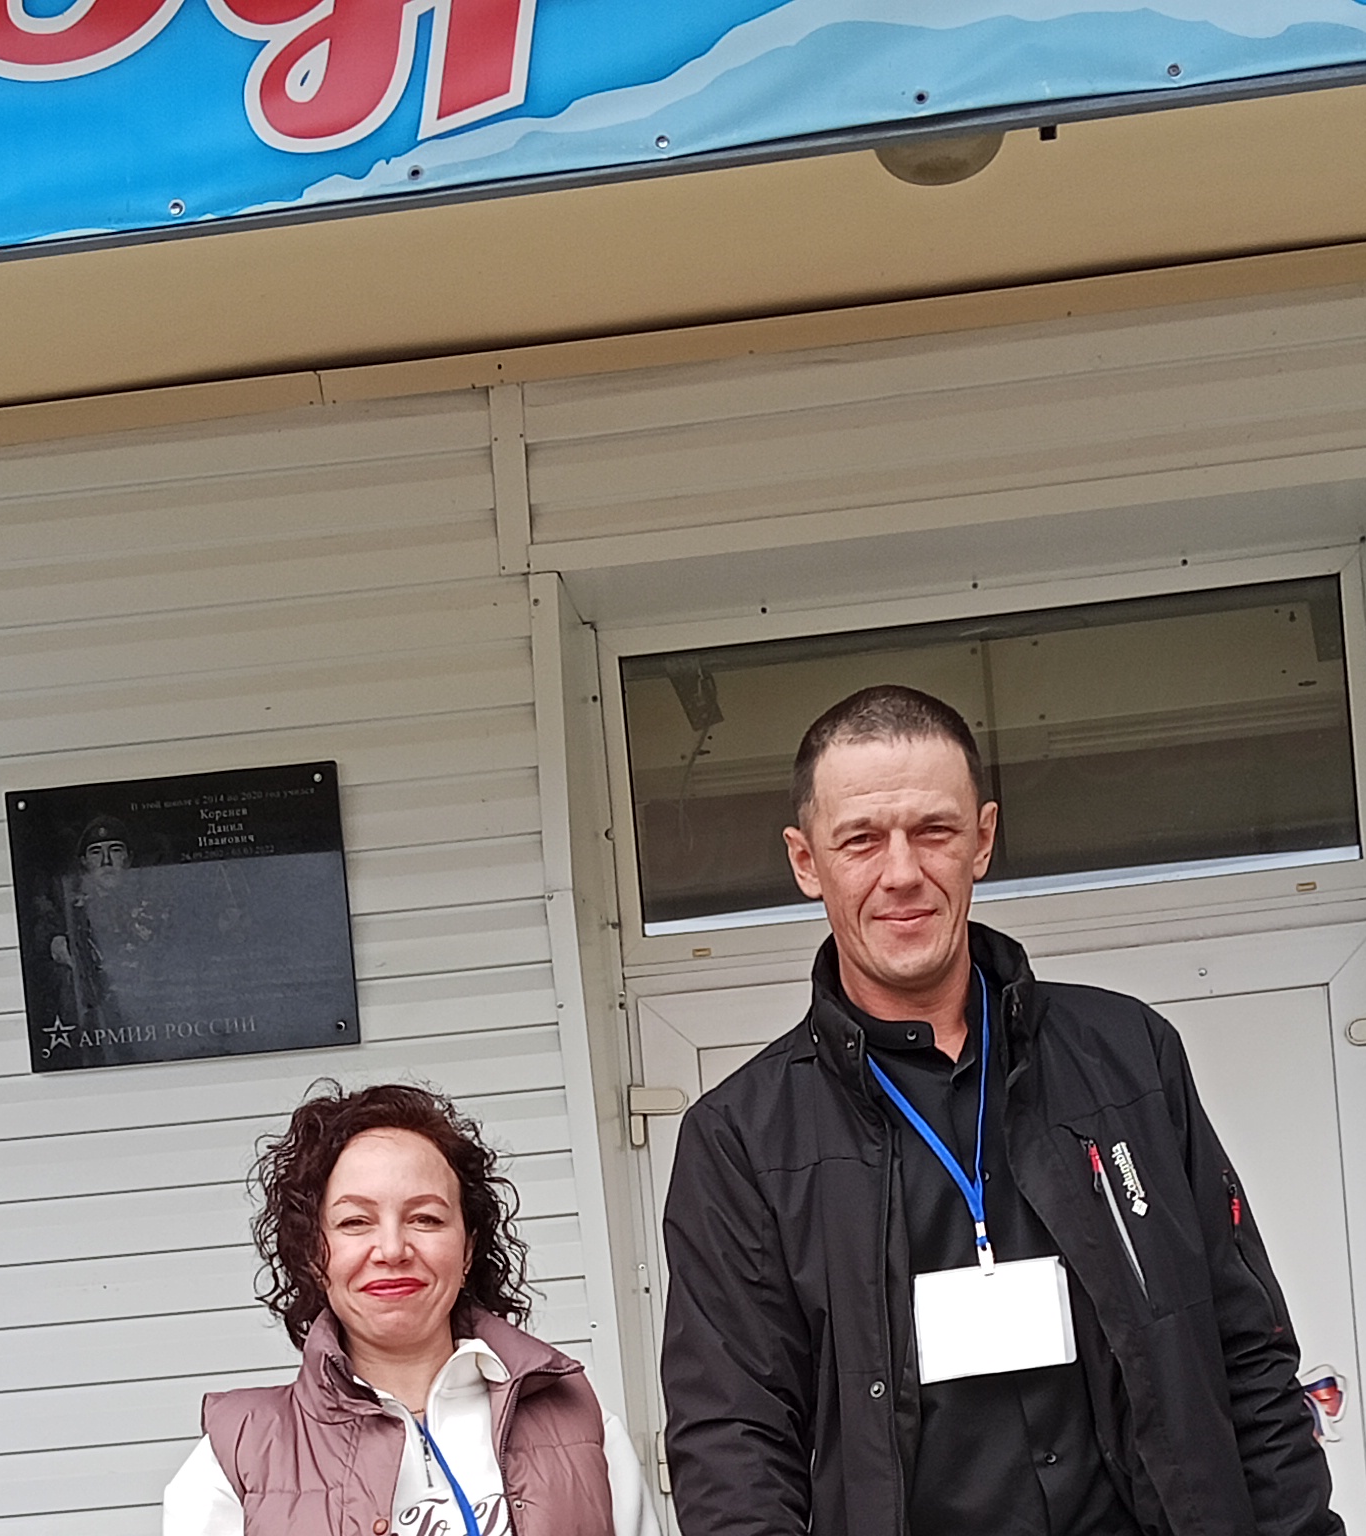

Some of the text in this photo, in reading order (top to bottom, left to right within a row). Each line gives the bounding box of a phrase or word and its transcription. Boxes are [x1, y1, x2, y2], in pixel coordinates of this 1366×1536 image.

[207, 822, 243, 836] Данил
[198, 834, 255, 848] Иванович
[79, 1015, 256, 1047] АРМИЯ РОССИИ
